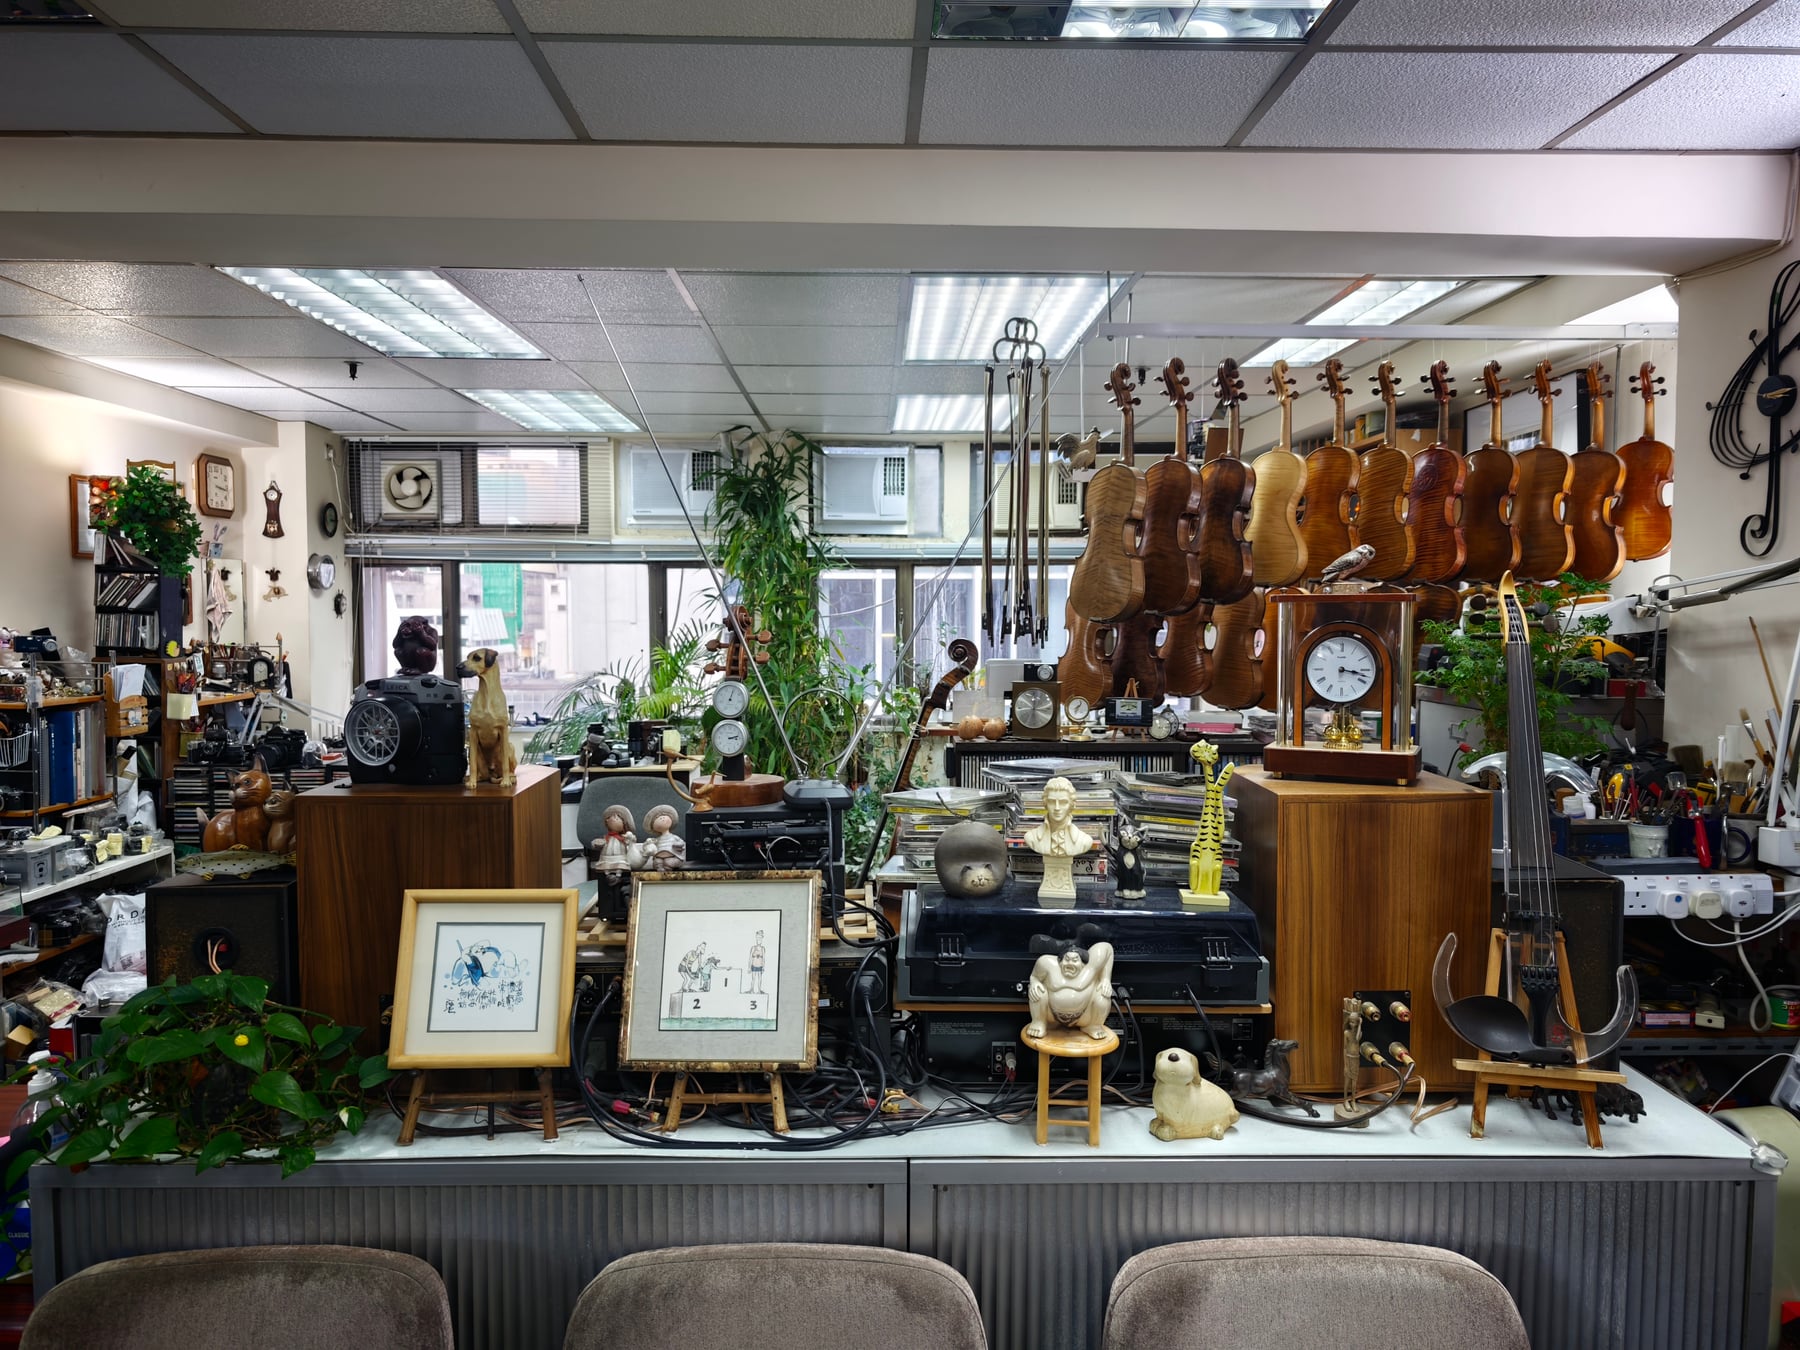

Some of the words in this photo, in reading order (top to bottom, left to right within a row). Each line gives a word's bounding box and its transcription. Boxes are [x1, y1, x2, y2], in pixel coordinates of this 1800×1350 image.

[724, 977, 728, 987] 1
[693, 998, 701, 1009] 2
[750, 1000, 757, 1010] 3
